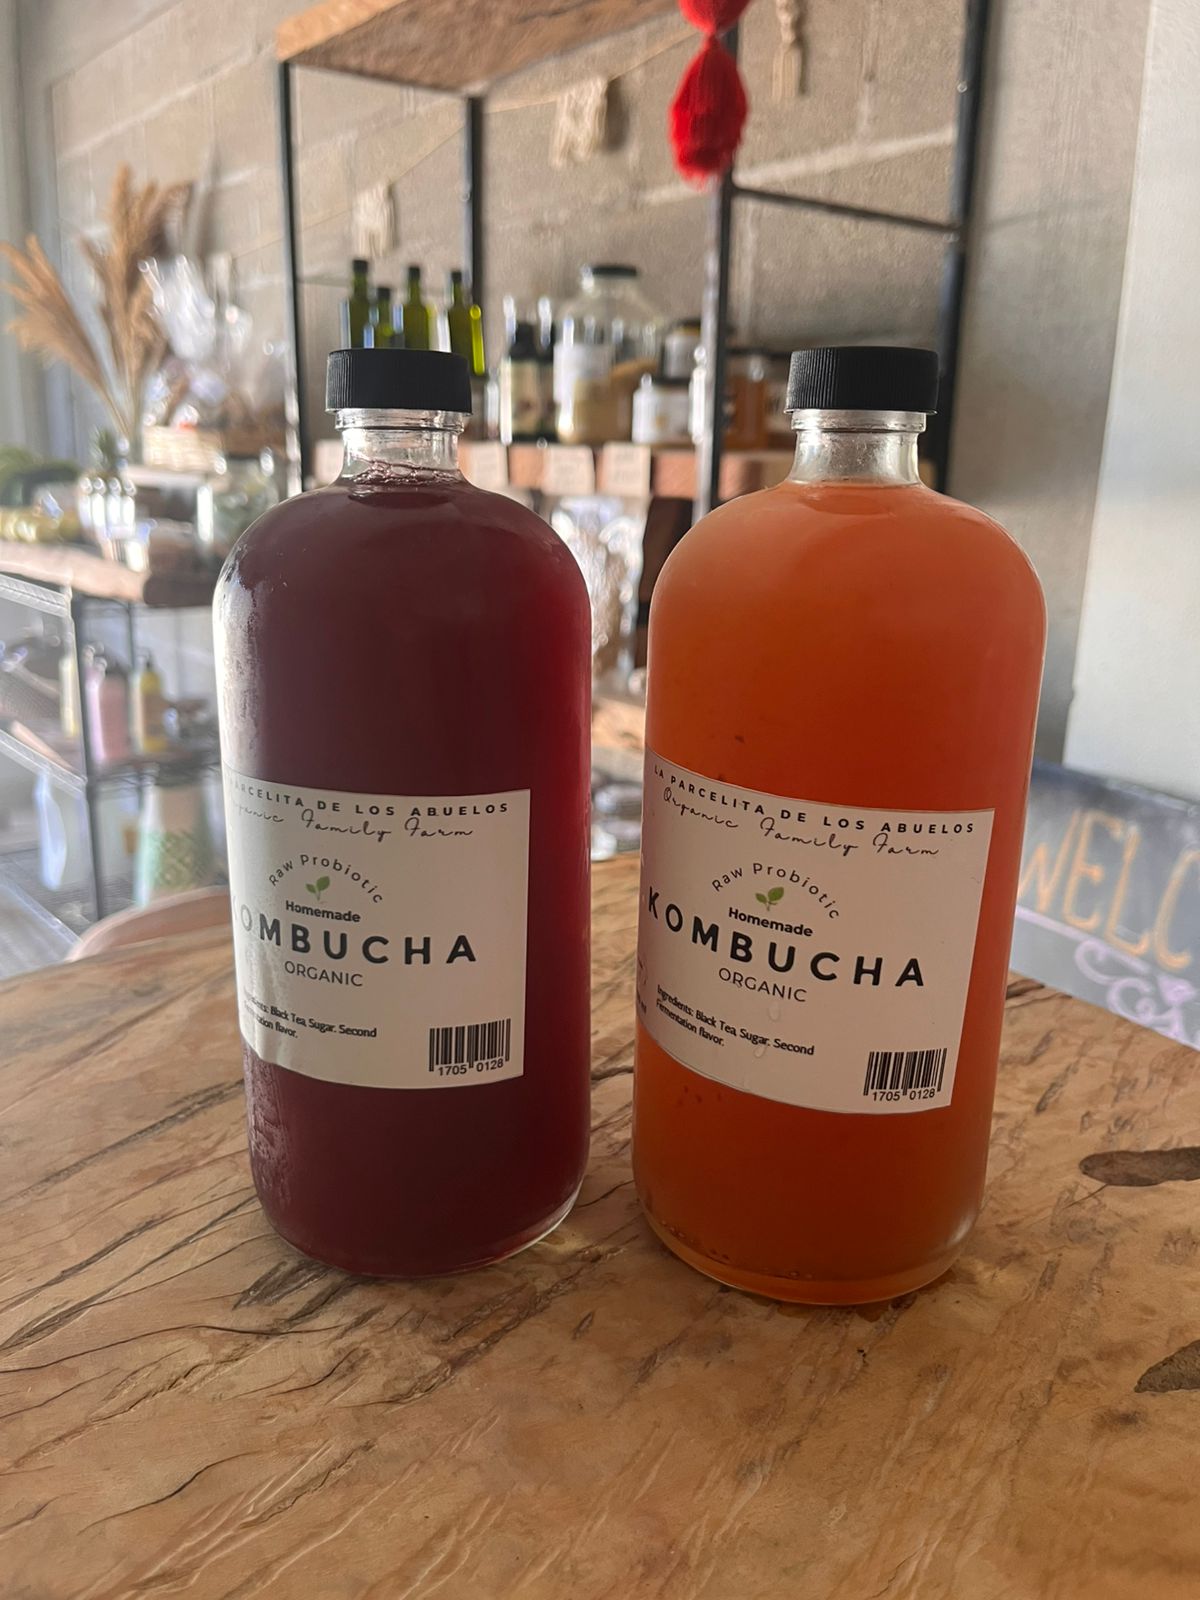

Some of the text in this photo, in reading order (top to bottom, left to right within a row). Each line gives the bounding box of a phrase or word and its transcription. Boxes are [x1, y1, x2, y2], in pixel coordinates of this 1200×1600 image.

[317, 800, 341, 812] DE
[355, 804, 395, 816] LOS
[410, 803, 508, 817] ABUELOS
[663, 786, 939, 857] Organic Family Farm
[670, 775, 765, 815] PARCELITA
[780, 809, 806, 822] DE
[823, 816, 865, 830] LOS
[880, 822, 974, 834] ABUELOS
[301, 808, 392, 843] Family
[404, 816, 474, 837] Farm
[269, 853, 384, 904] Raw Probiotic
[711, 862, 840, 919] Raw Probiotic
[285, 899, 362, 923] Homemade
[728, 906, 814, 938] Homemade
[233, 895, 477, 965] OMBUCHA
[648, 885, 925, 987] KOMBUCHA
[283, 960, 364, 988] ORGANIC
[718, 967, 809, 1003] ORGANIC
[270, 1005, 289, 1021] Black
[338, 1024, 378, 1039] Second
[274, 1021, 299, 1039] flavor.
[656, 997, 698, 1035] Fermentation
[698, 1026, 726, 1048] flavor.
[657, 983, 694, 1018] Ingredients:
[696, 1008, 718, 1030] Black
[773, 1038, 816, 1057] Second
[439, 1057, 504, 1077] 1705 0128
[872, 1088, 936, 1102] 1705 0128
